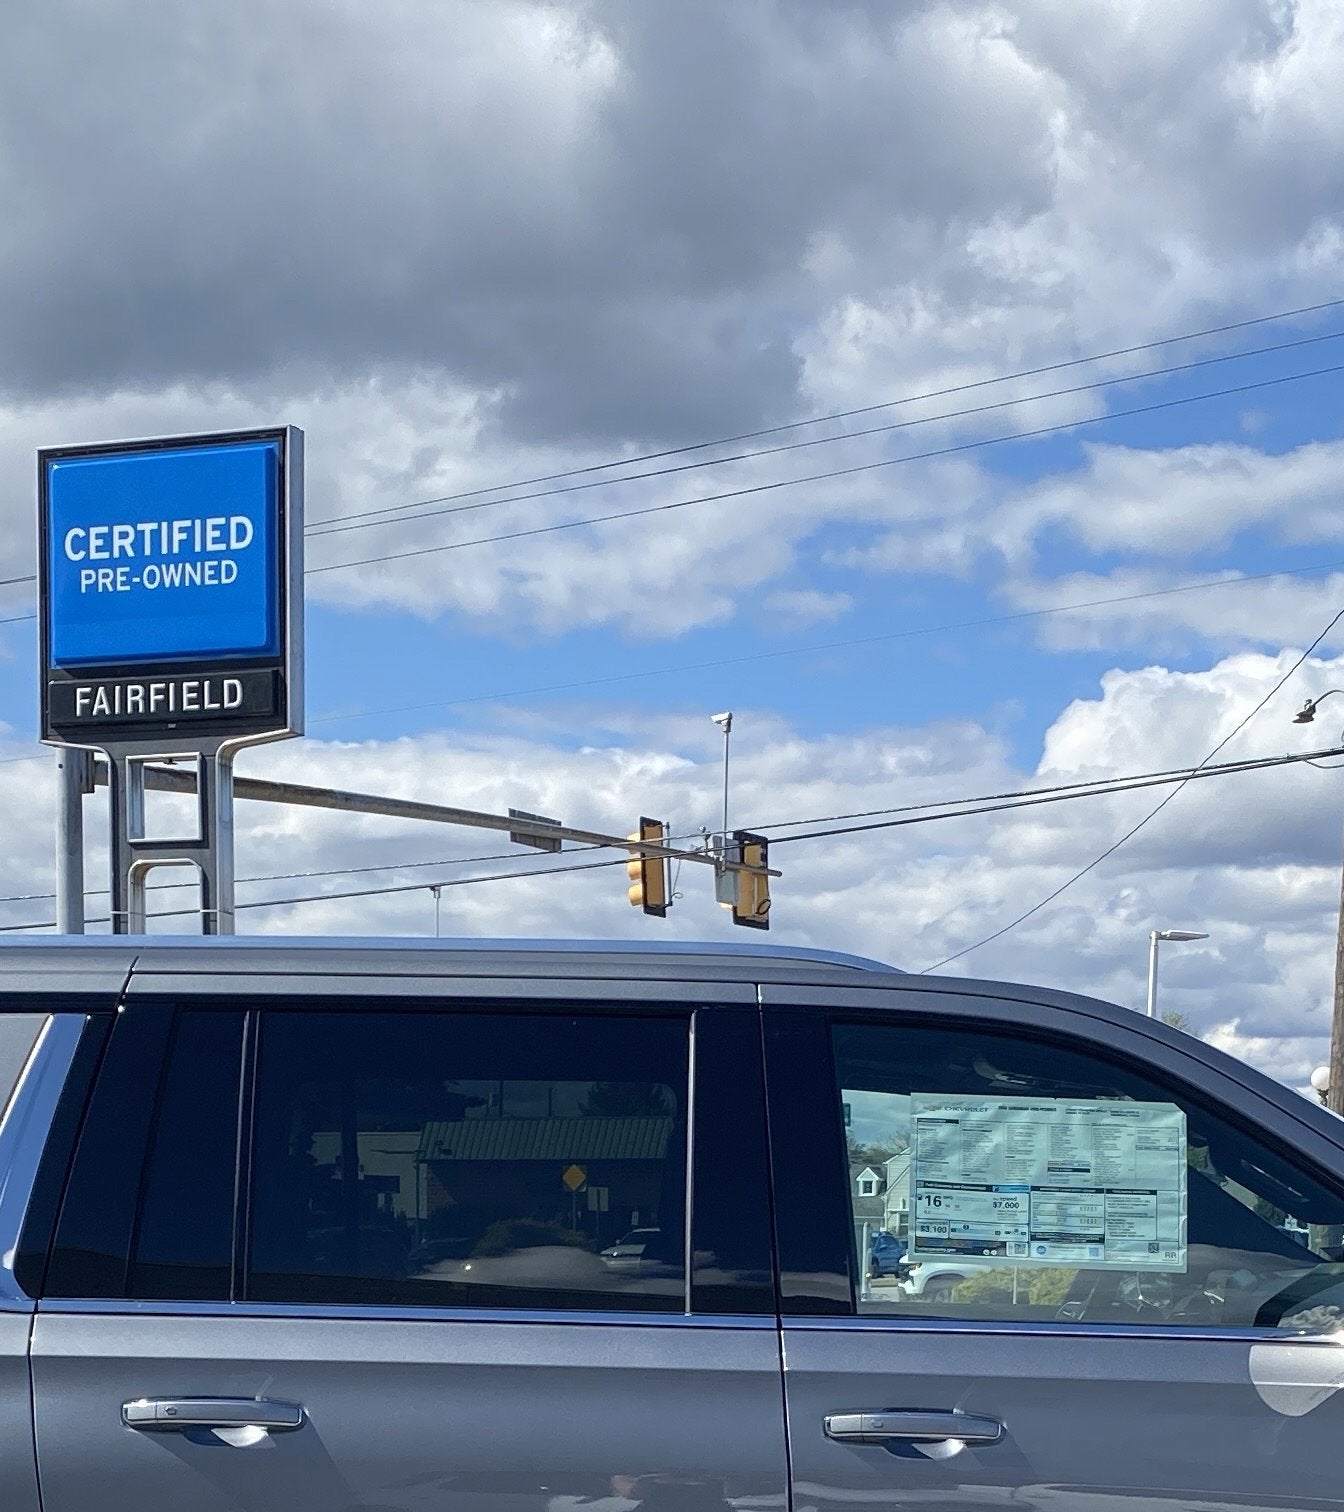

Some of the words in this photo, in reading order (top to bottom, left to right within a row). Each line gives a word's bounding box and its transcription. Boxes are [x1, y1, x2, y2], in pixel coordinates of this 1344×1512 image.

[64, 515, 254, 562] CERTIFIED
[80, 559, 238, 594] PRE-OWNED
[75, 678, 243, 717] FAIRFIELD
[924, 1195, 942, 1208] 16
